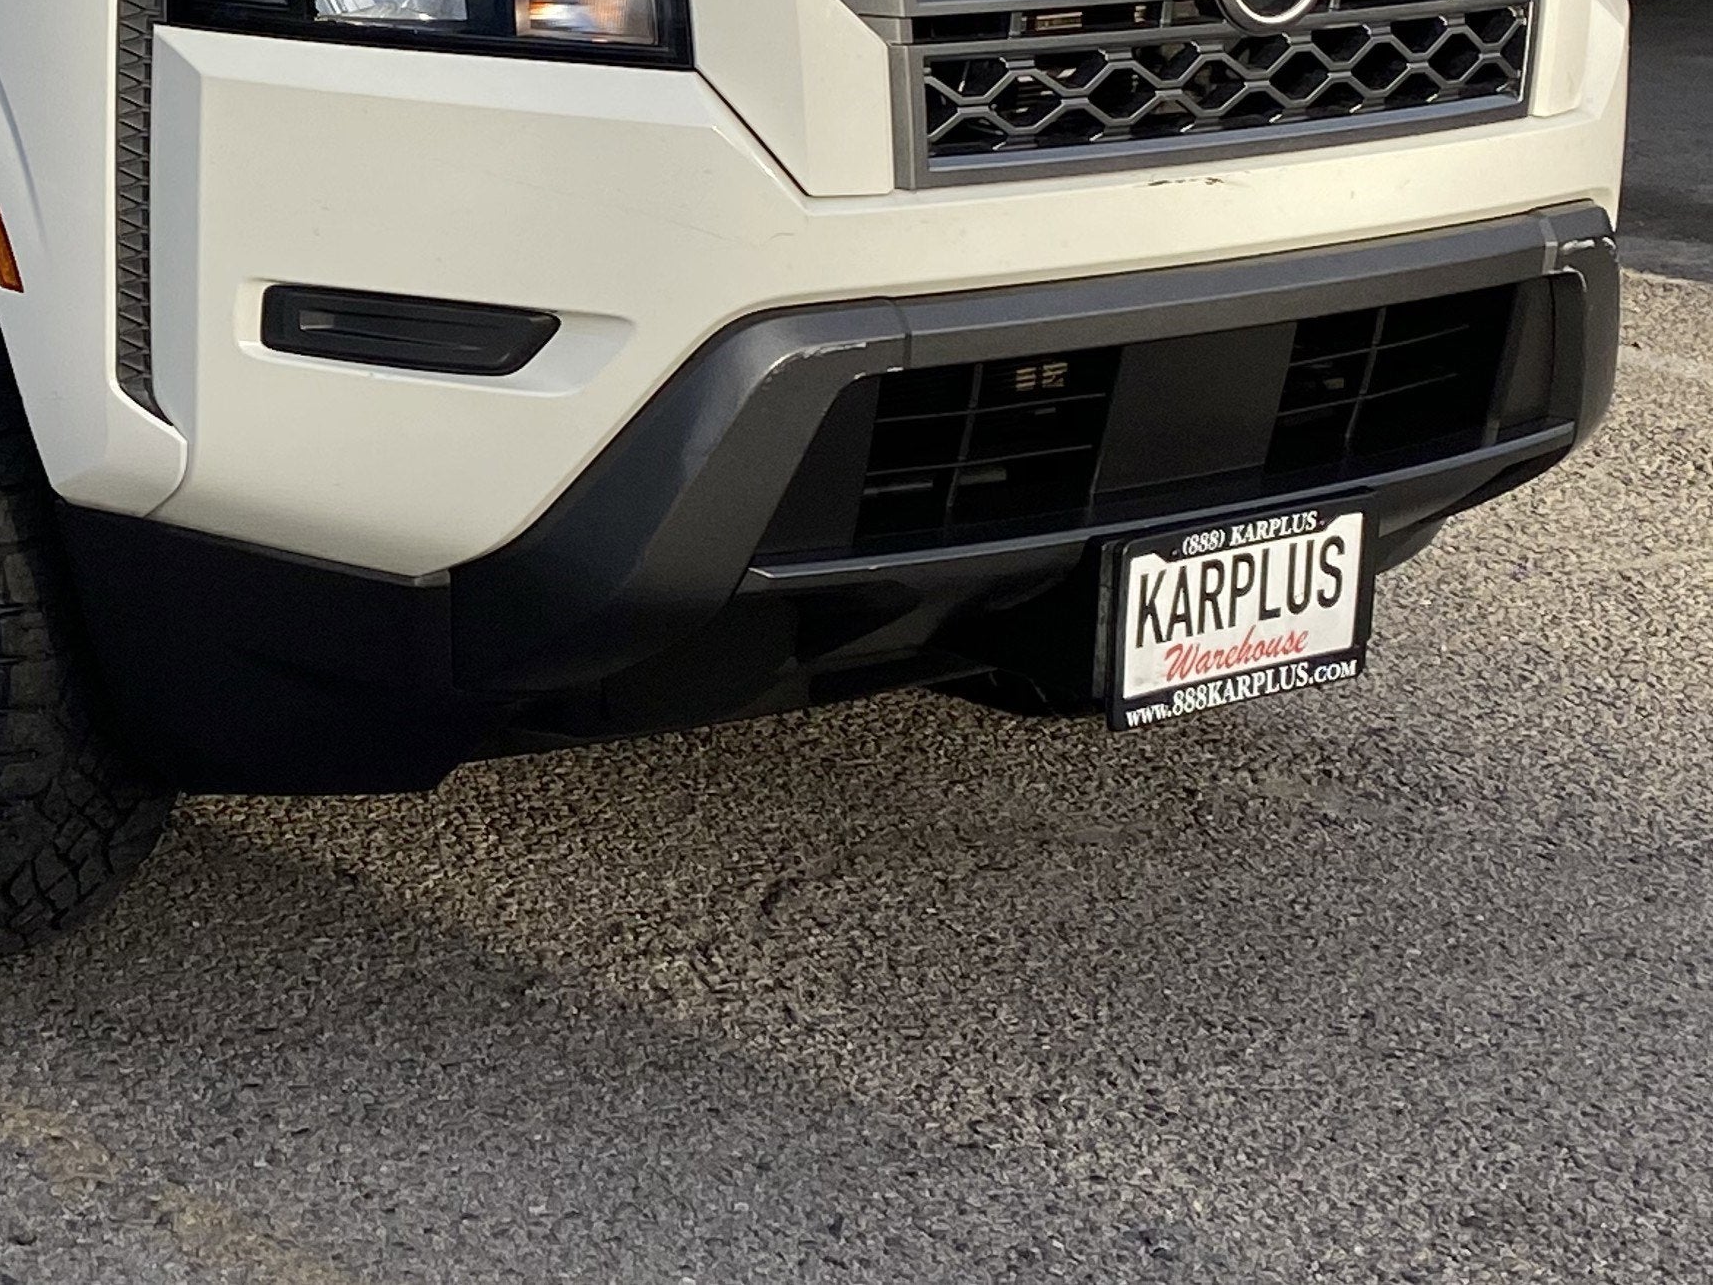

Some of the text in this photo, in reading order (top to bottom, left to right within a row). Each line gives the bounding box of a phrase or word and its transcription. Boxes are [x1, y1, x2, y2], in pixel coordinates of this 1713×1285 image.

[1182, 510, 1318, 556] (888) KARPLUS
[1136, 535, 1345, 648] KARPLUS
[1164, 624, 1309, 681] Warehouse
